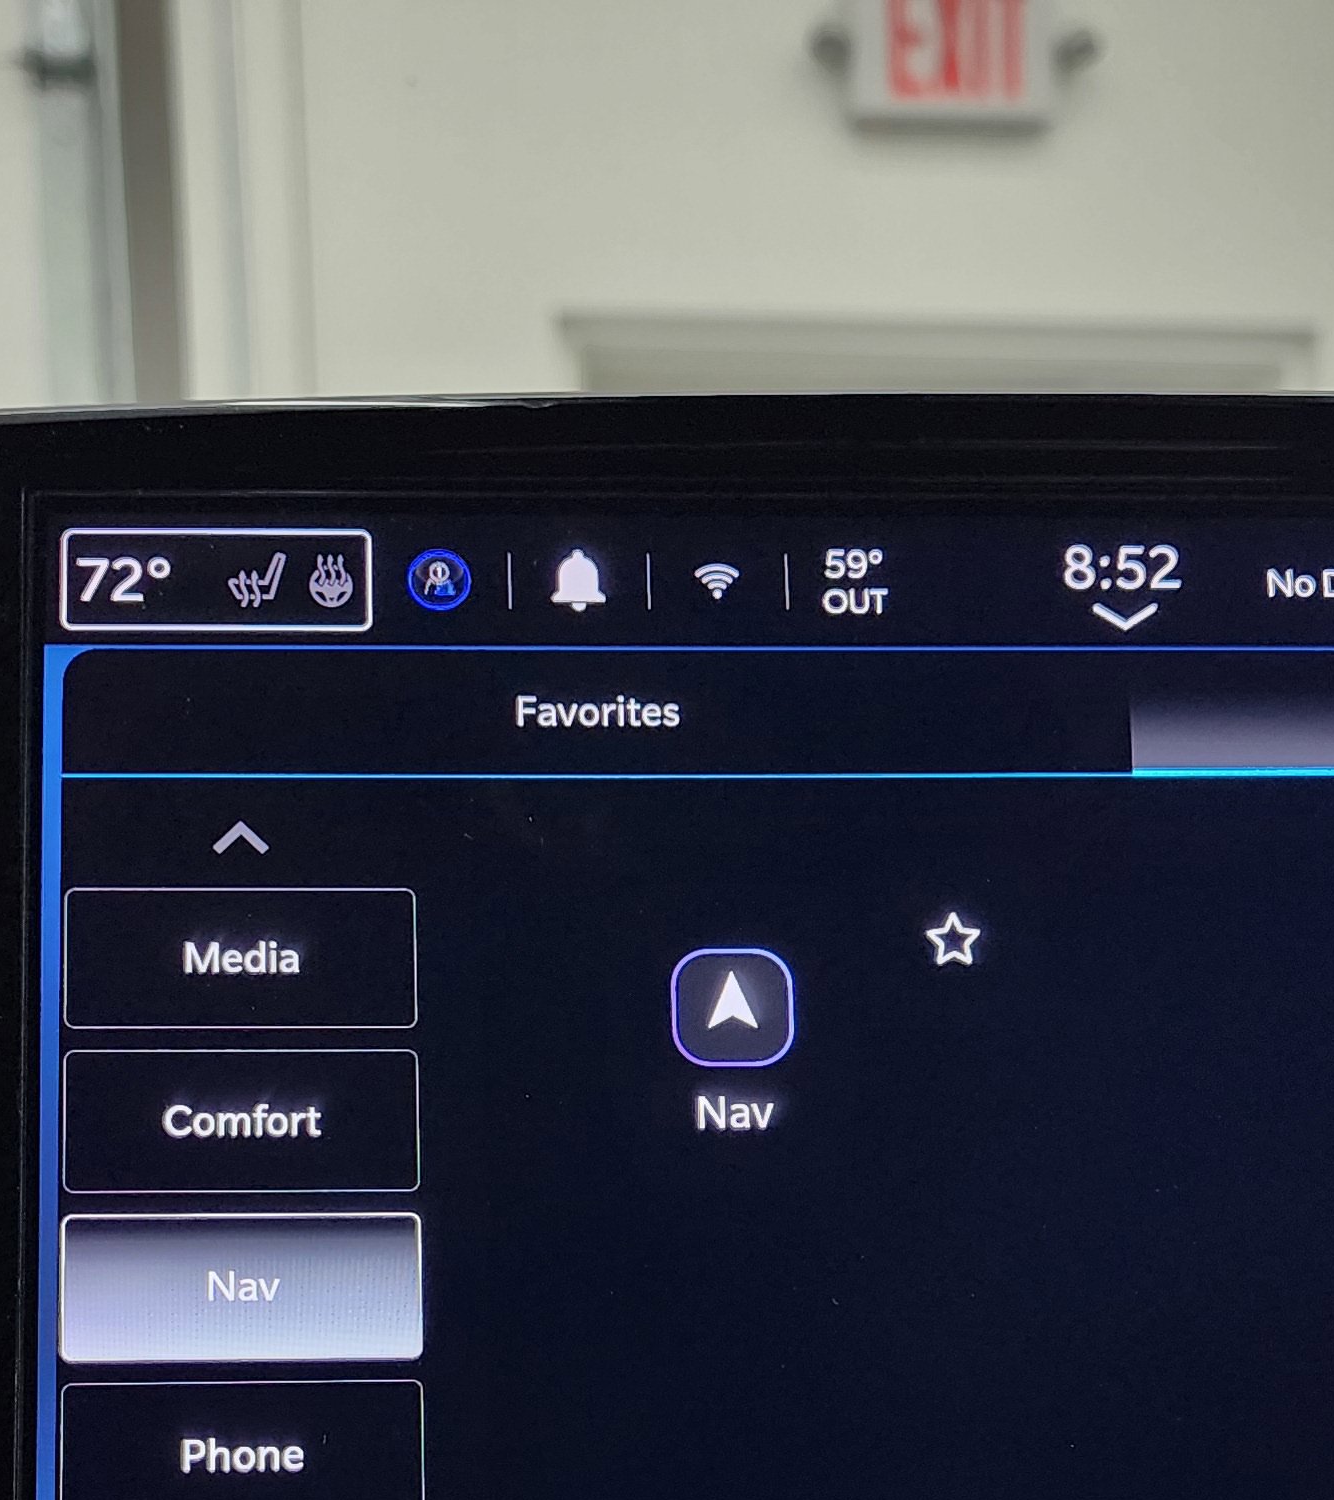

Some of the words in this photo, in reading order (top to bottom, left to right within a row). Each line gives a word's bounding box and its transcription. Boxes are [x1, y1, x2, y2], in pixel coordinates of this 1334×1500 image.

[1063, 543, 1183, 591] 8:52
[1265, 567, 1317, 599] No
[821, 586, 890, 616] OUT
[515, 694, 681, 728] Favorites
[183, 939, 301, 975] Media
[161, 1102, 323, 1139] Comfort
[696, 1094, 776, 1131] Nav
[206, 1269, 282, 1303] Nav
[180, 1436, 305, 1475] Phone
